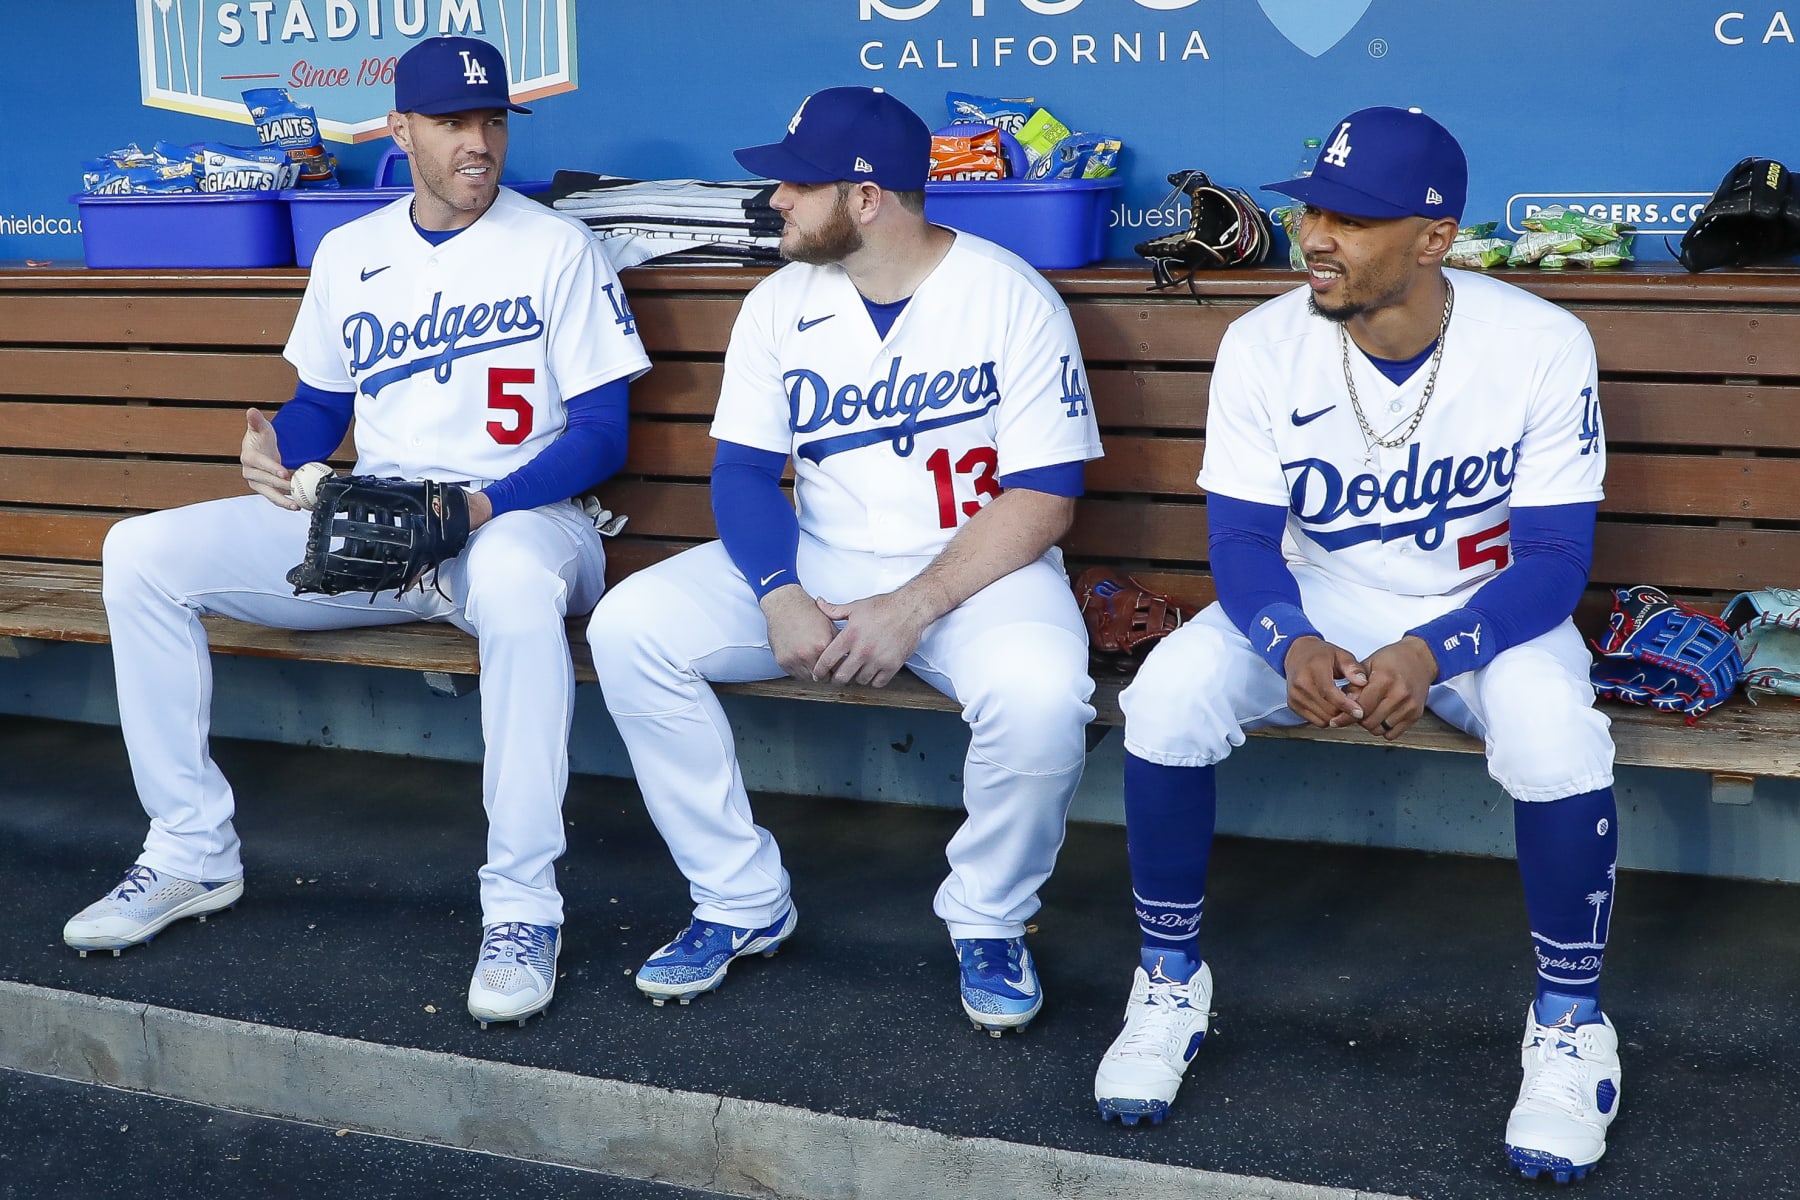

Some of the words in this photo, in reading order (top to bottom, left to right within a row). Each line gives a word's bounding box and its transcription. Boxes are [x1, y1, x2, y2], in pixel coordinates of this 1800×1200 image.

[217, 0, 485, 45] STADIUM
[458, 50, 489, 85] LA
[859, 30, 1211, 71] CALIFORNIA
[287, 59, 350, 89] Since
[255, 116, 315, 145] GIANTS
[1323, 122, 1352, 168] LA
[207, 169, 275, 193] GIANTS
[343, 291, 544, 392] Dodgers
[486, 367, 536, 446] 5
[783, 356, 1002, 458] Dodgers
[1060, 355, 1089, 418] LA
[926, 446, 1004, 530] 13
